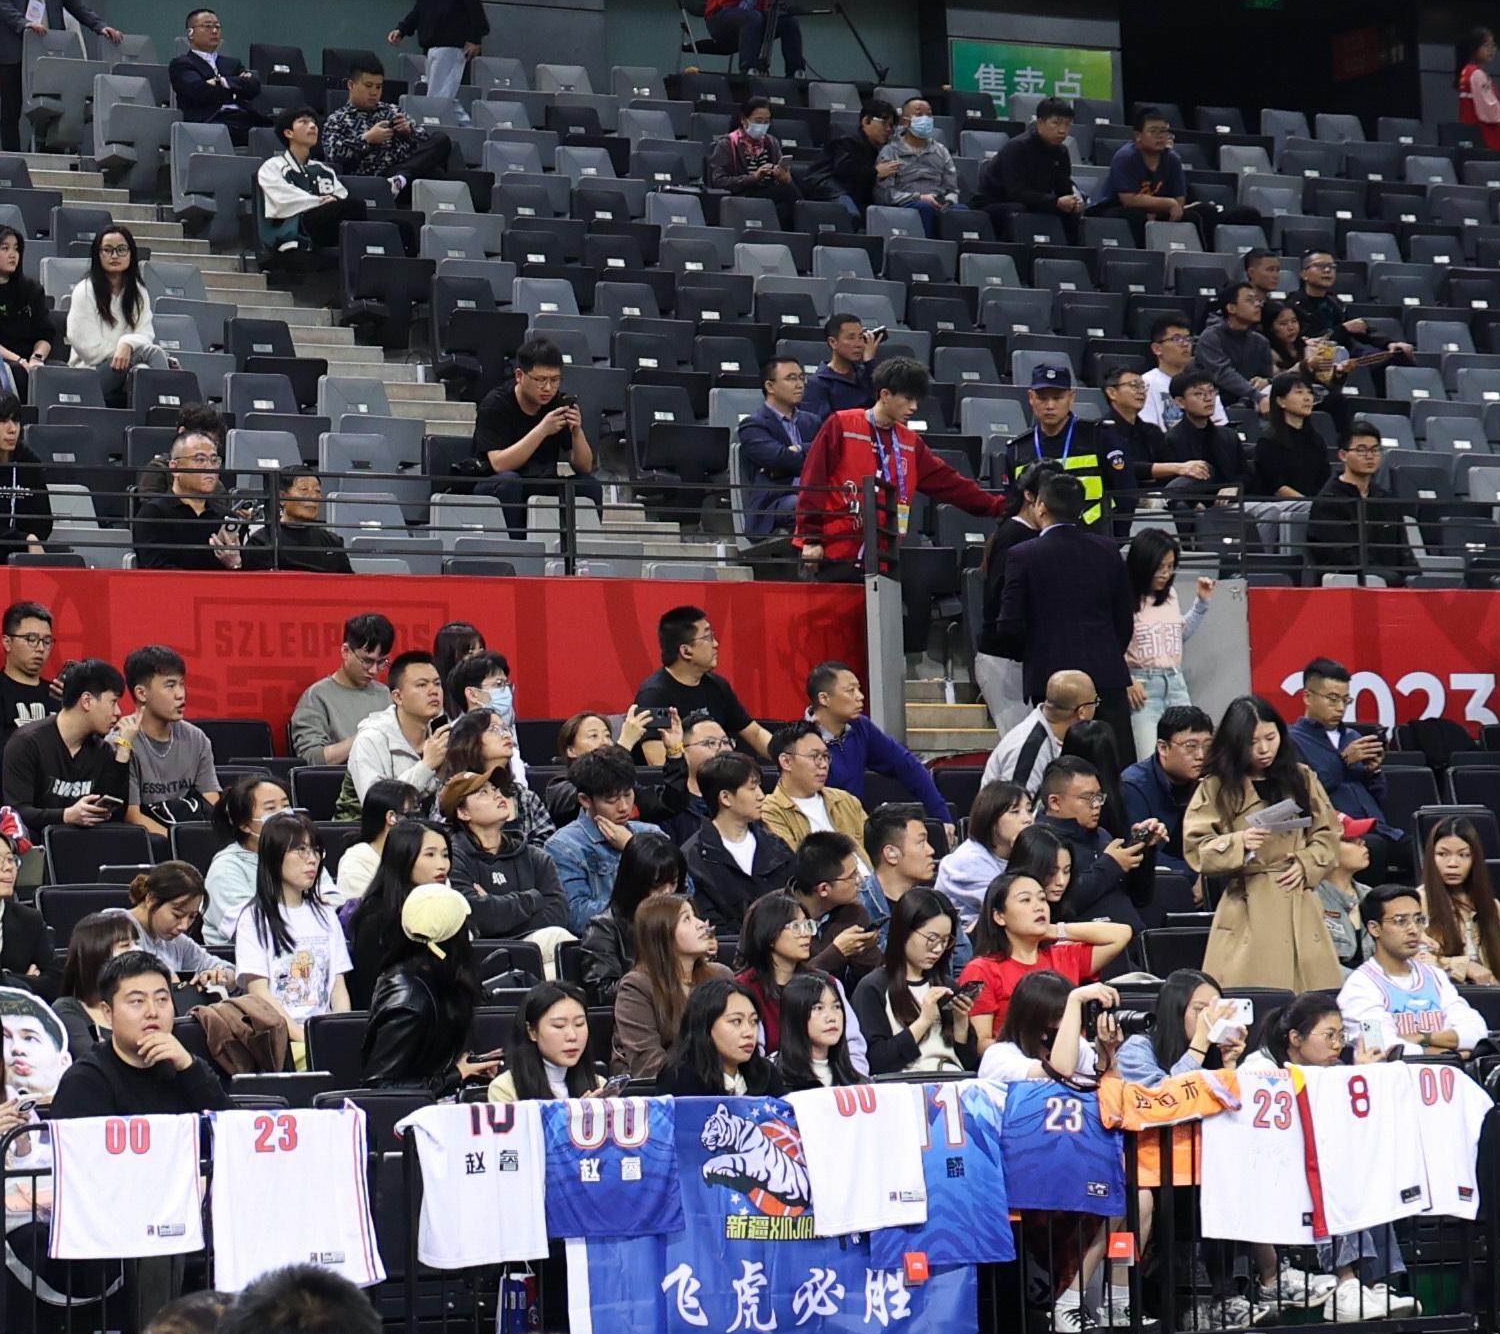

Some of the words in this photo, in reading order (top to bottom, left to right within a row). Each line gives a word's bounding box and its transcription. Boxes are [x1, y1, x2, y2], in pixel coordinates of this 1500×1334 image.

[1348, 1075, 1370, 1118] 8
[1420, 1068, 1455, 1106] 00
[1045, 1097, 1084, 1133] 23
[1253, 1088, 1293, 1130] 23
[104, 1117, 151, 1155] 00
[254, 1115, 299, 1153] 23
[465, 1149, 520, 1175] 赵睿
[579, 1156, 643, 1183] 赵睿
[660, 1258, 913, 1334] 飞虎必胜
